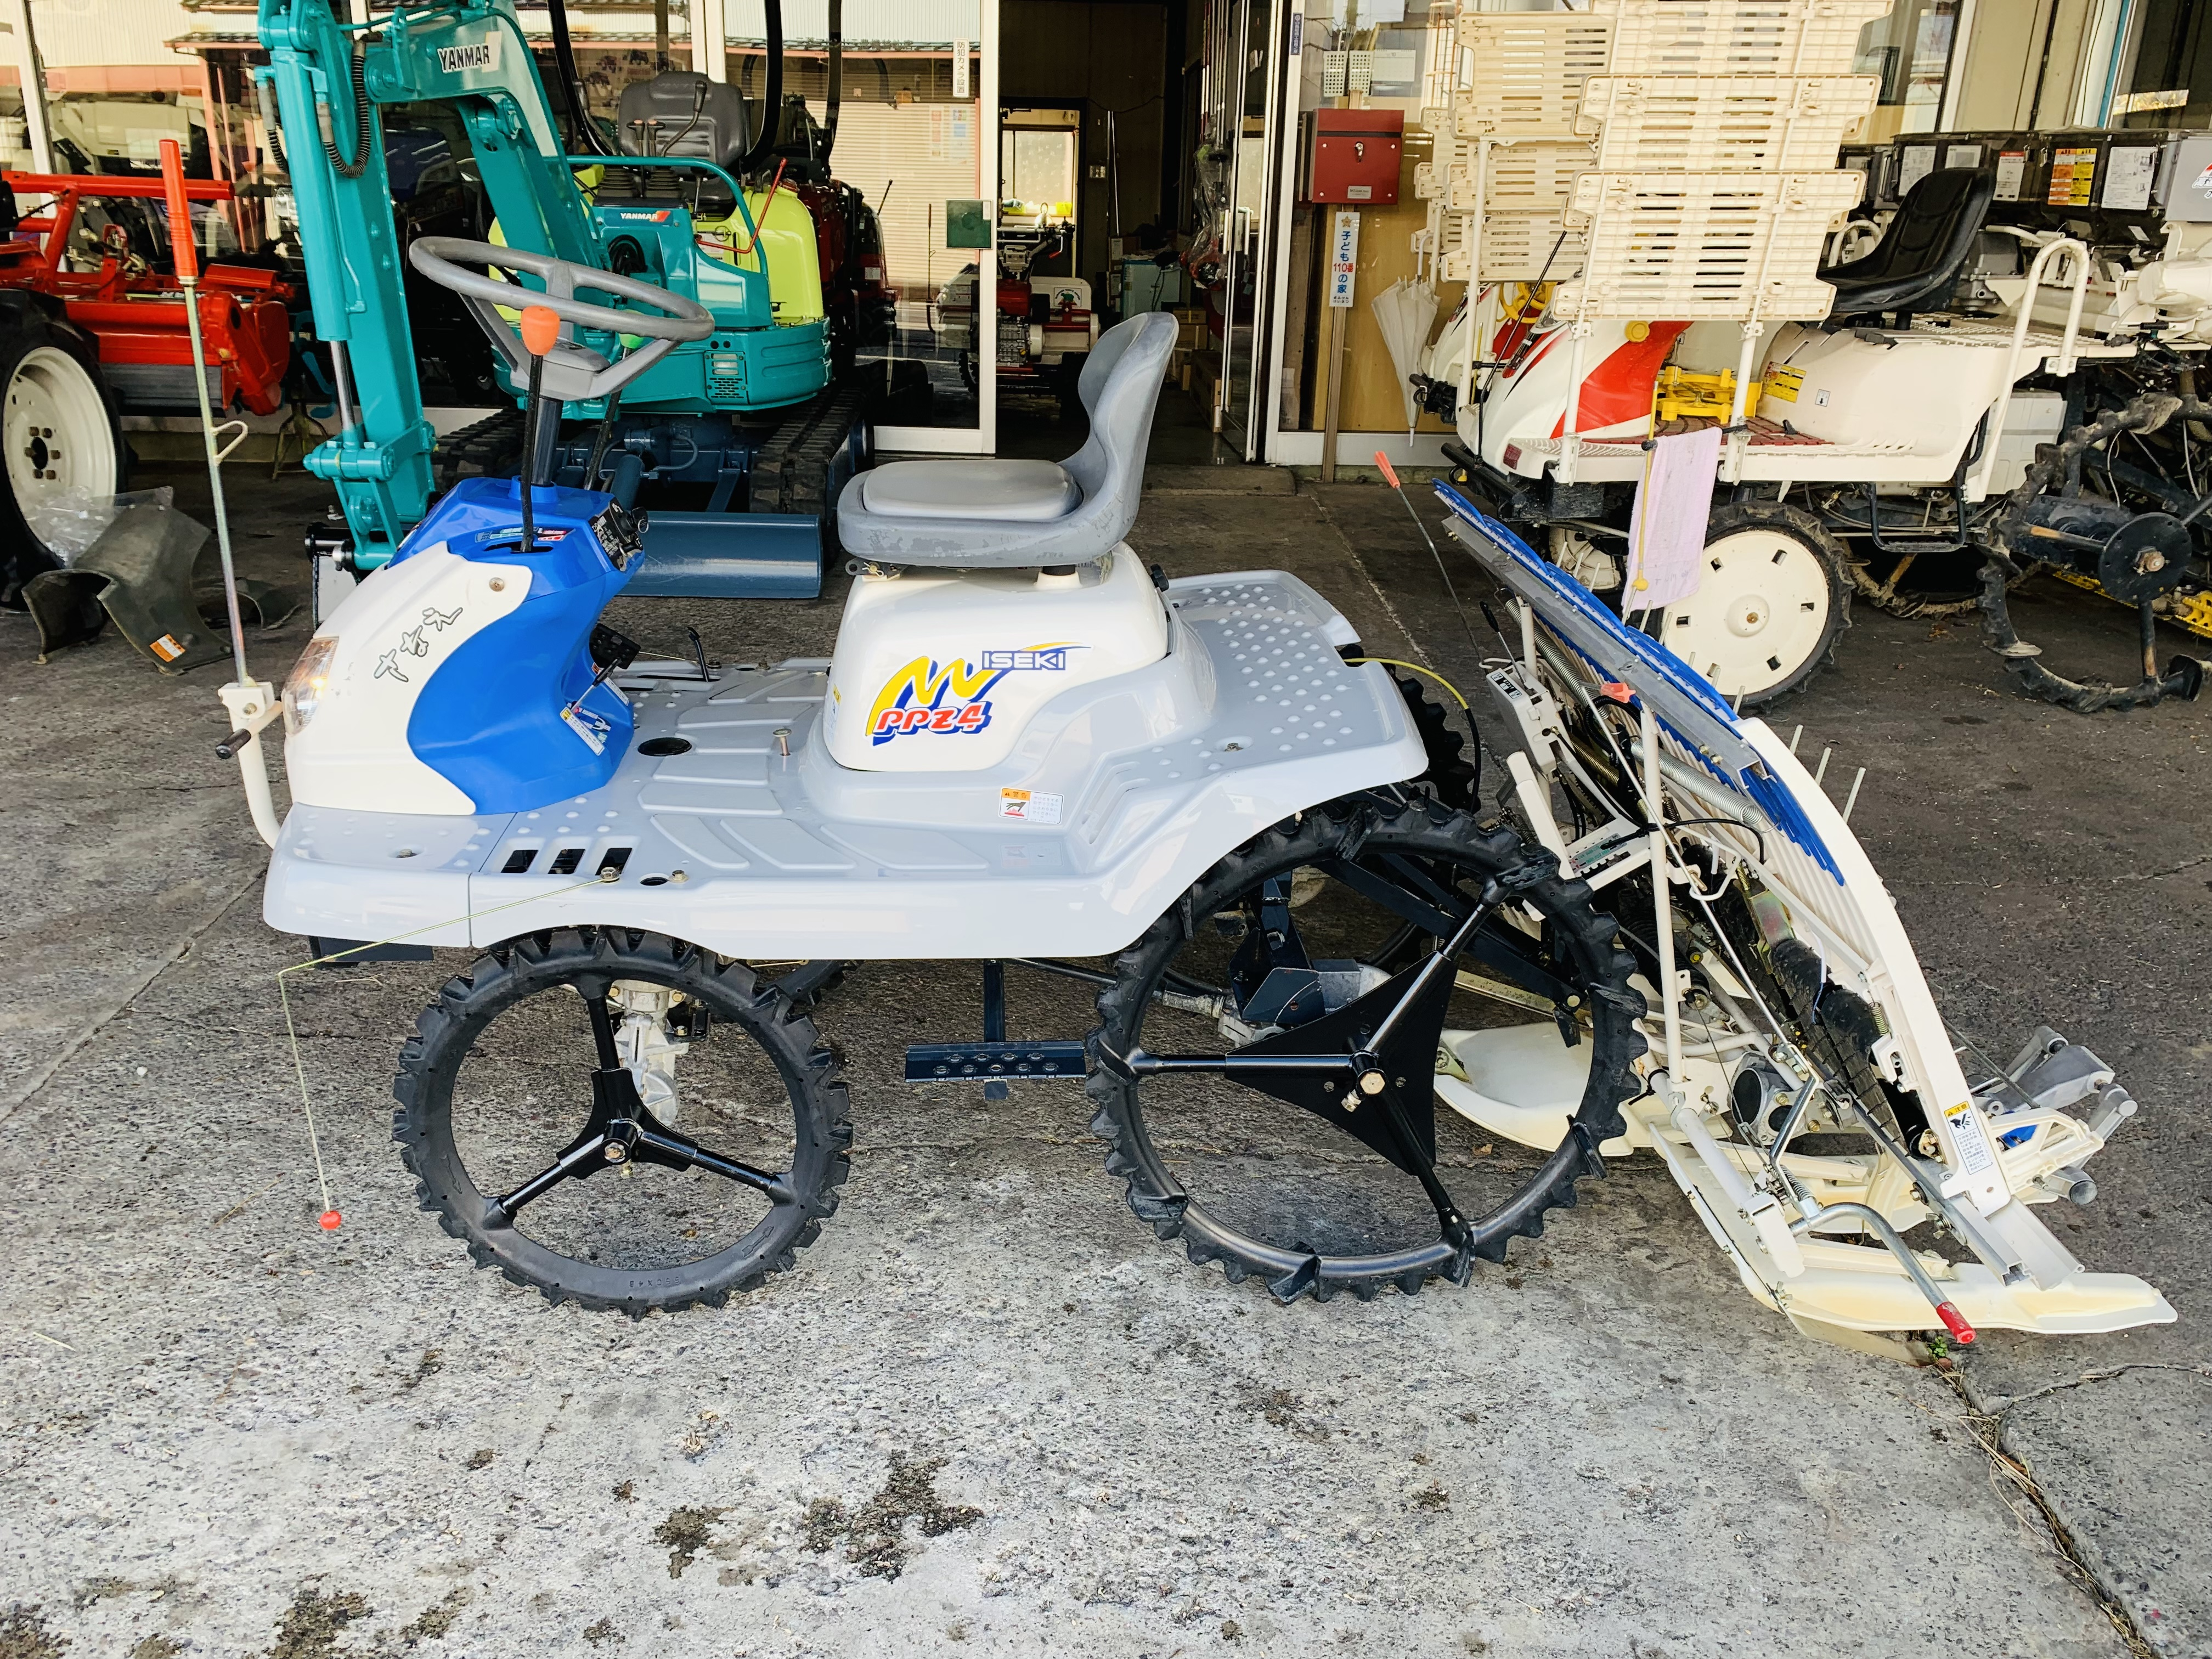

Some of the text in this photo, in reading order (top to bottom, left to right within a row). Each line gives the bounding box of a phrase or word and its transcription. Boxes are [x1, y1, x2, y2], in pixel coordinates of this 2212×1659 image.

[437, 44, 490, 72] YANMAR
[956, 41, 966, 94] 防犯カメラ設置
[983, 651, 1065, 670] ISEKI
[1954, 1103, 1967, 1113] 注意
